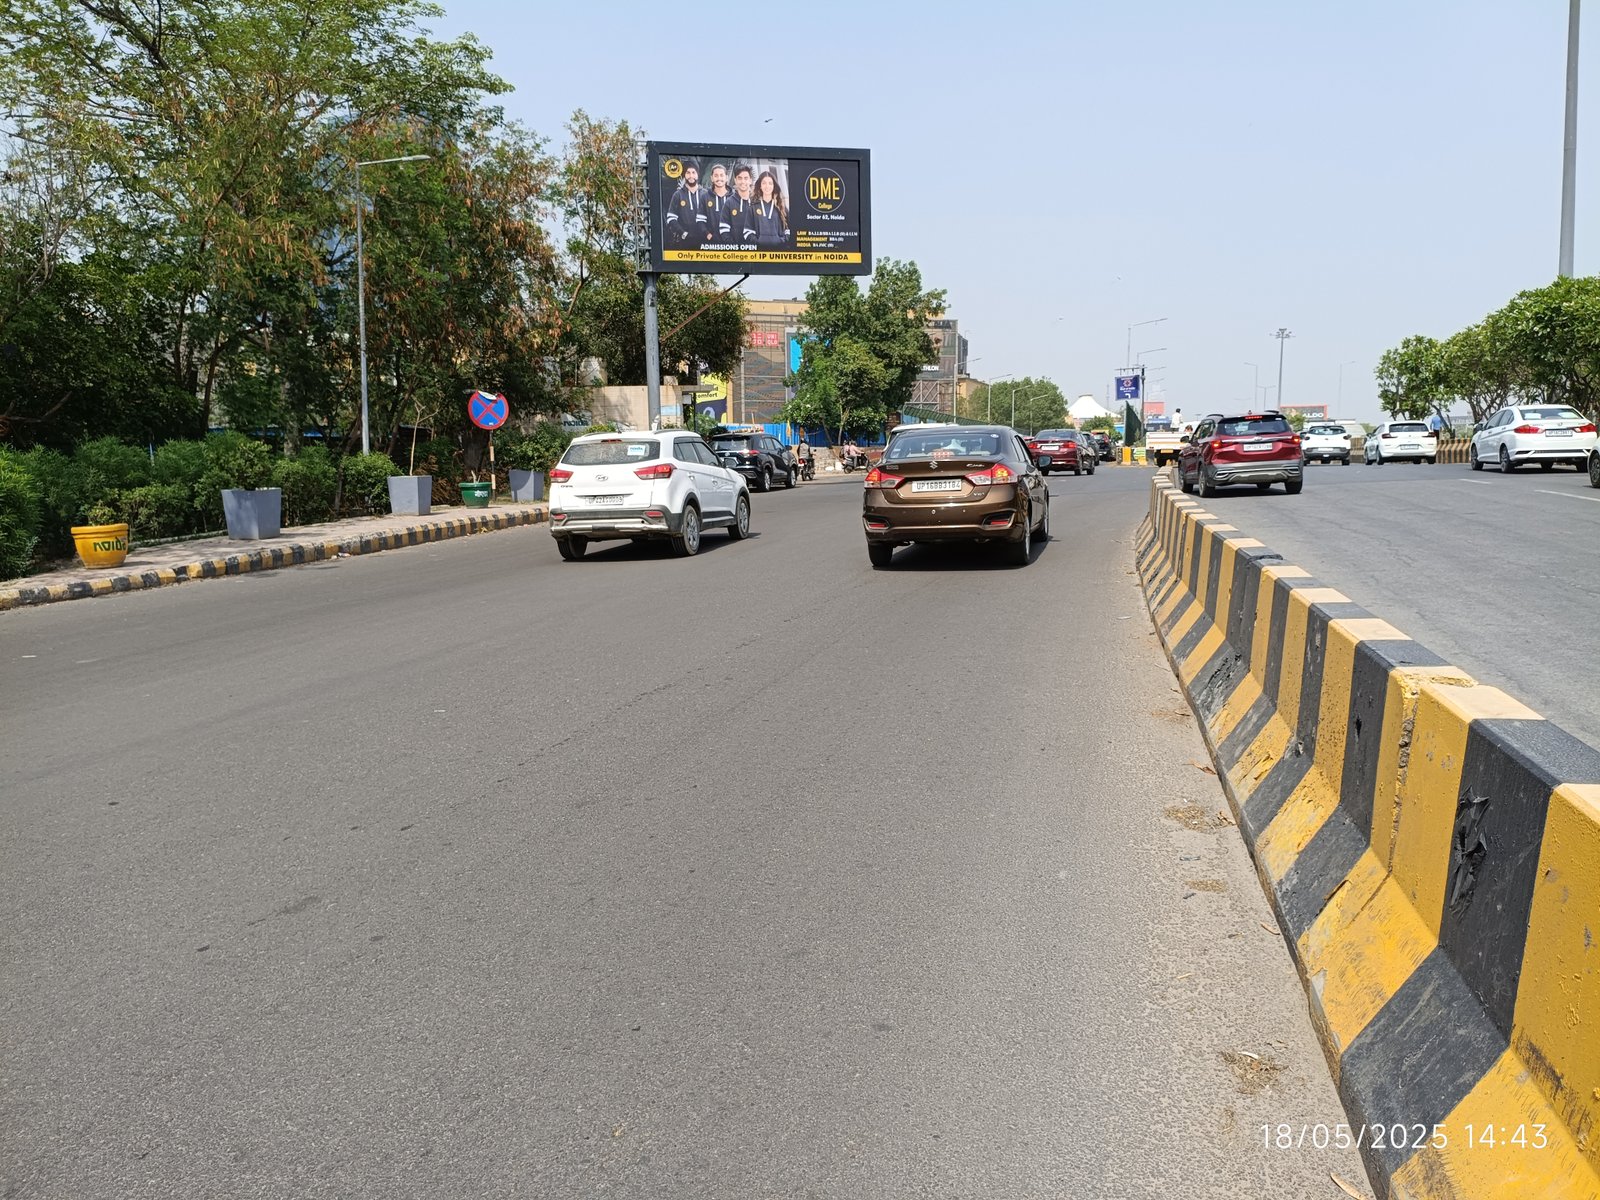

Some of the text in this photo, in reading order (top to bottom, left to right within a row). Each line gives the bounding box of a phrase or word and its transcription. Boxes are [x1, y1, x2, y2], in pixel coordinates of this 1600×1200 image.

[809, 177, 840, 200] DME
[818, 202, 832, 210] College
[700, 243, 739, 251] ADMISSIONS
[677, 252, 694, 260] Only
[696, 252, 721, 260] Private
[722, 252, 748, 261] College
[749, 252, 757, 260] of
